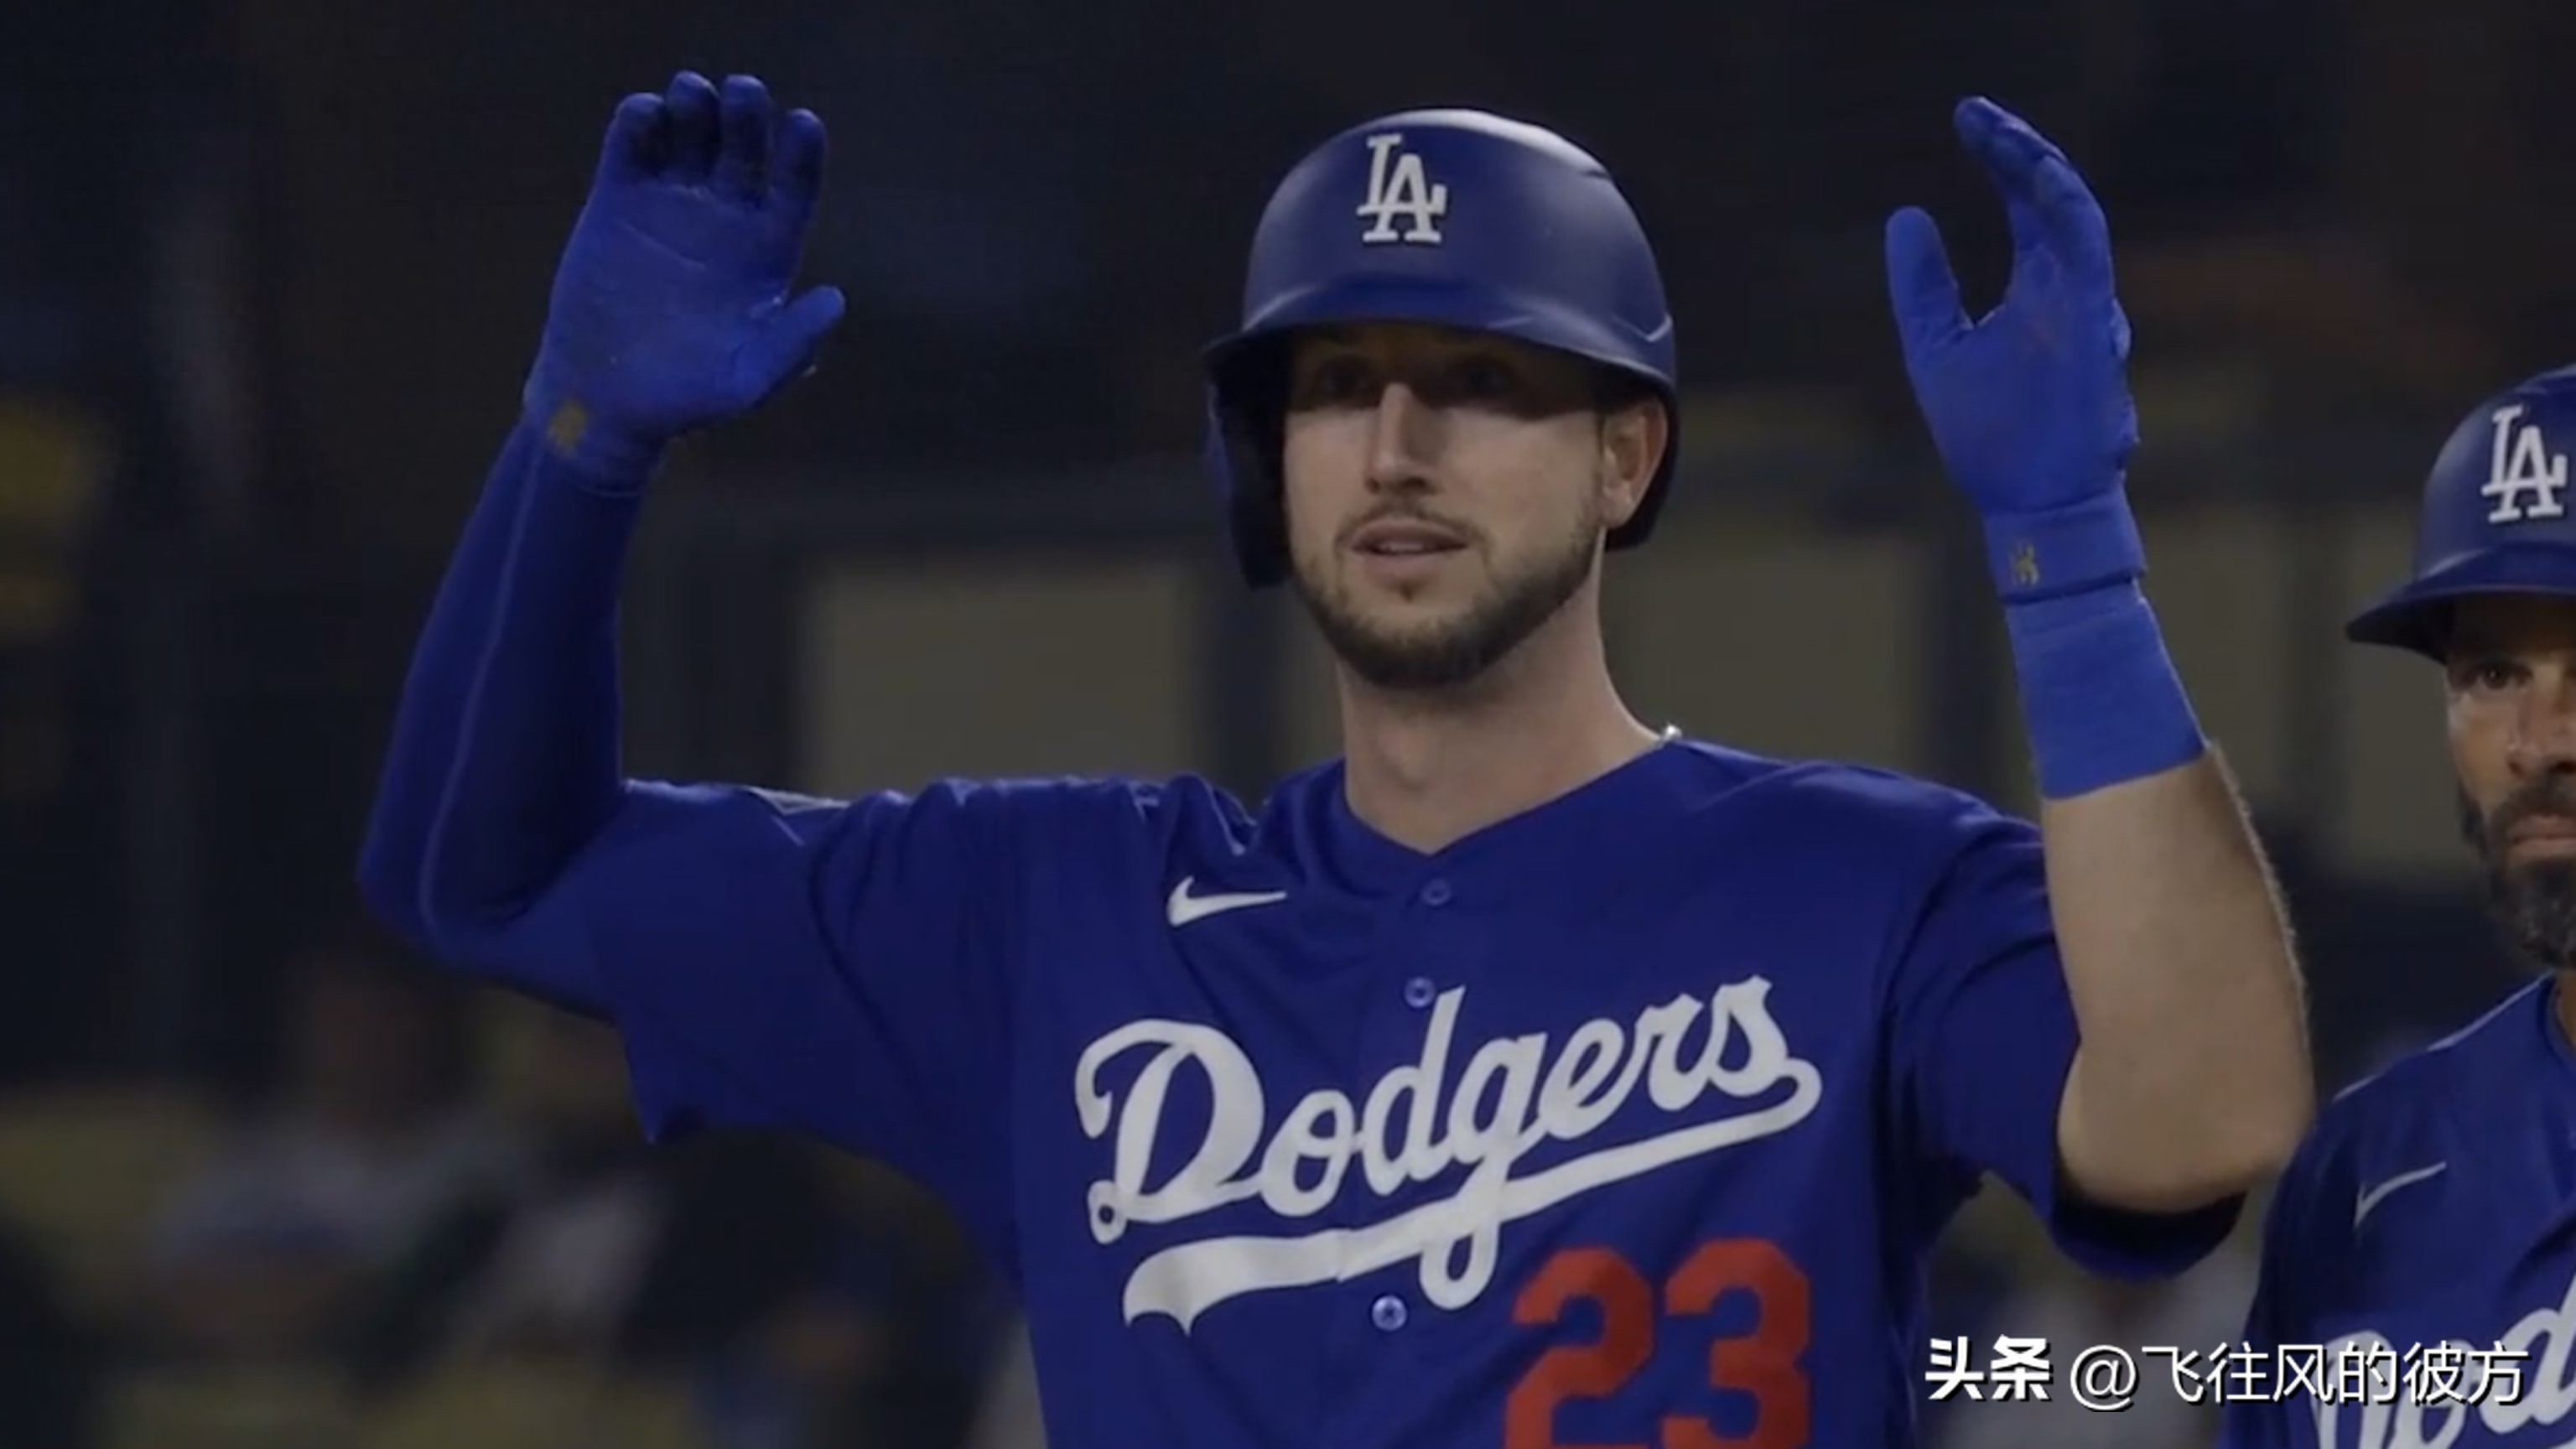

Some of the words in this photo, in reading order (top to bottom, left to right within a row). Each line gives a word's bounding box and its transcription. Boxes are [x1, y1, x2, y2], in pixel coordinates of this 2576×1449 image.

[1356, 133, 1447, 243] LA
[2480, 404, 2568, 523] LA
[1075, 974, 1821, 1312] Dodgers
[1505, 1238, 1810, 1449] 23
